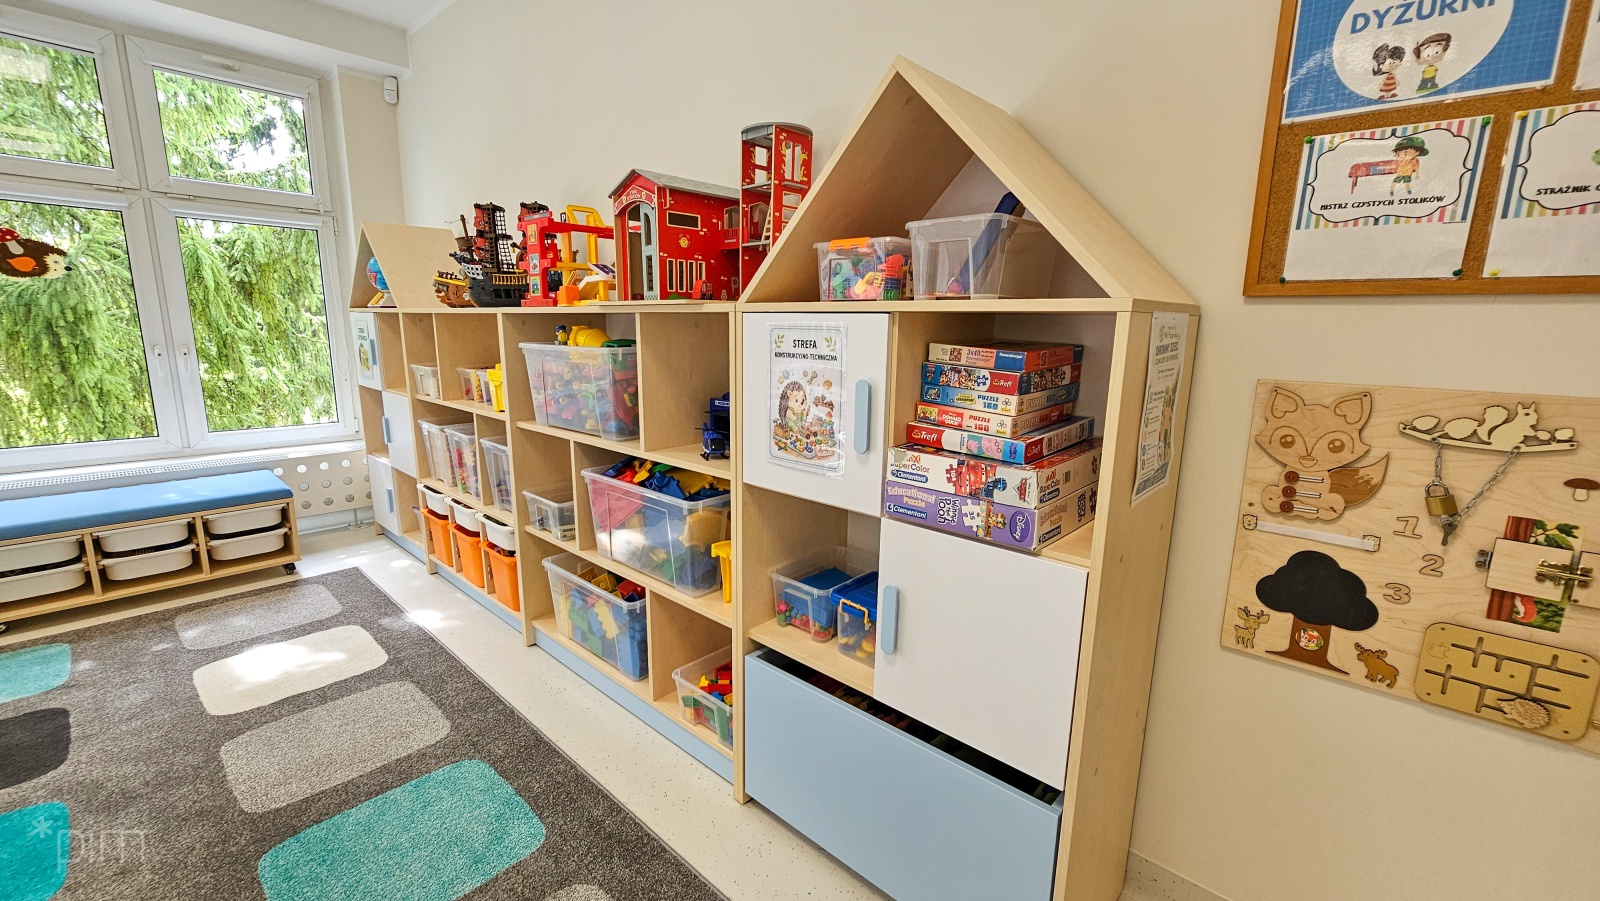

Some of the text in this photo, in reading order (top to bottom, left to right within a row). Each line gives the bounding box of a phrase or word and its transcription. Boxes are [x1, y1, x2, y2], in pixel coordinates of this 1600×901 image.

[1535, 184, 1591, 196] STRAŻNIK
[1320, 195, 1446, 211] MISTRZ CZYSTYCH STOLIKÓW
[792, 339, 817, 349] STREFA
[774, 351, 838, 361] KONSTRUKCYJNO-TECHNICZNA
[966, 348, 981, 357] 3x49
[999, 379, 1013, 388] Trefl
[977, 394, 999, 402] PUZZLE
[1026, 395, 1046, 409] PUZZLE
[983, 402, 999, 410] 160
[942, 413, 962, 422] DONALD
[944, 418, 959, 426] DUCK
[968, 414, 991, 423] PUZZLE
[974, 423, 990, 432] 160
[920, 433, 938, 442] Trefl
[888, 486, 936, 505] Educational
[903, 496, 926, 508] Puzzle
[893, 506, 927, 519] Clementoni
[937, 497, 951, 525] Pooh
[949, 498, 960, 525] Winnie
[968, 510, 976, 521] 35
[1012, 511, 1026, 540] Disney
[1393, 516, 1422, 539] 1
[1419, 553, 1444, 577] 2
[1383, 582, 1411, 604] 3
